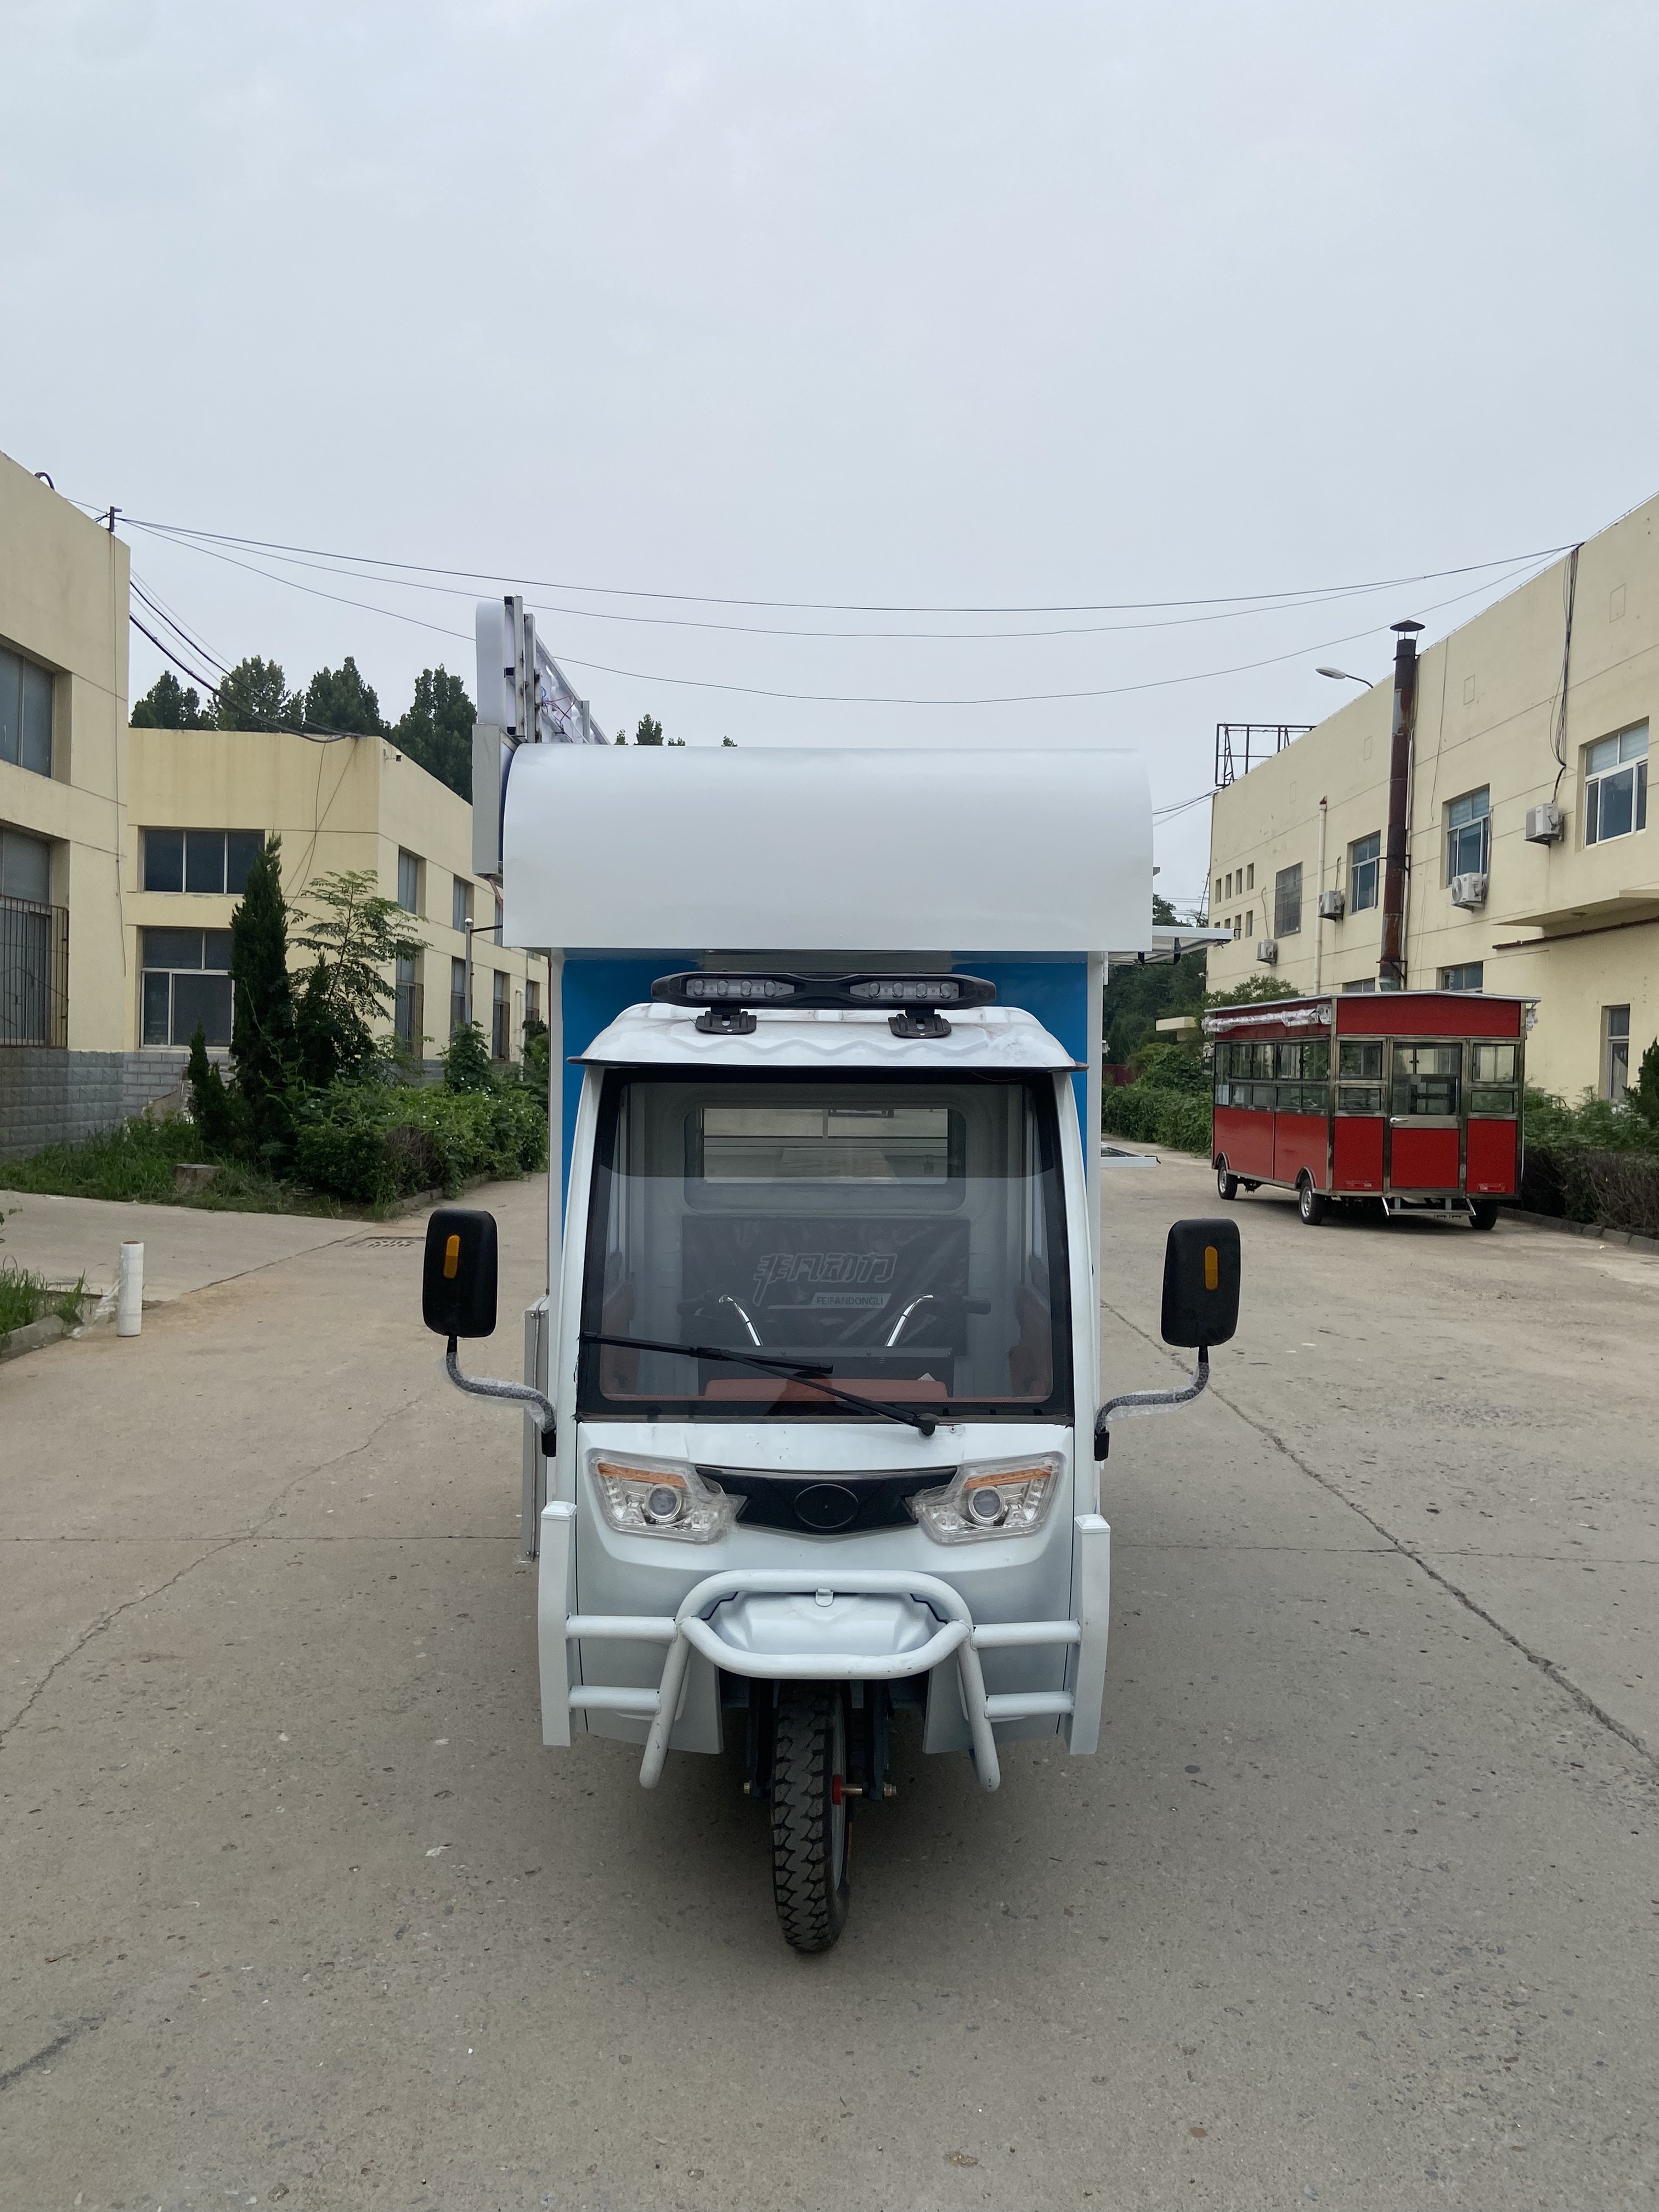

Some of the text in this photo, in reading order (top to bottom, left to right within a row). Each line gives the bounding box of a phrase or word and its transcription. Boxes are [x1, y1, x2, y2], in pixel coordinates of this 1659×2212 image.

[753, 1252, 898, 1307] 非凡动力
[817, 1297, 883, 1305] FEIFANDONGLI
